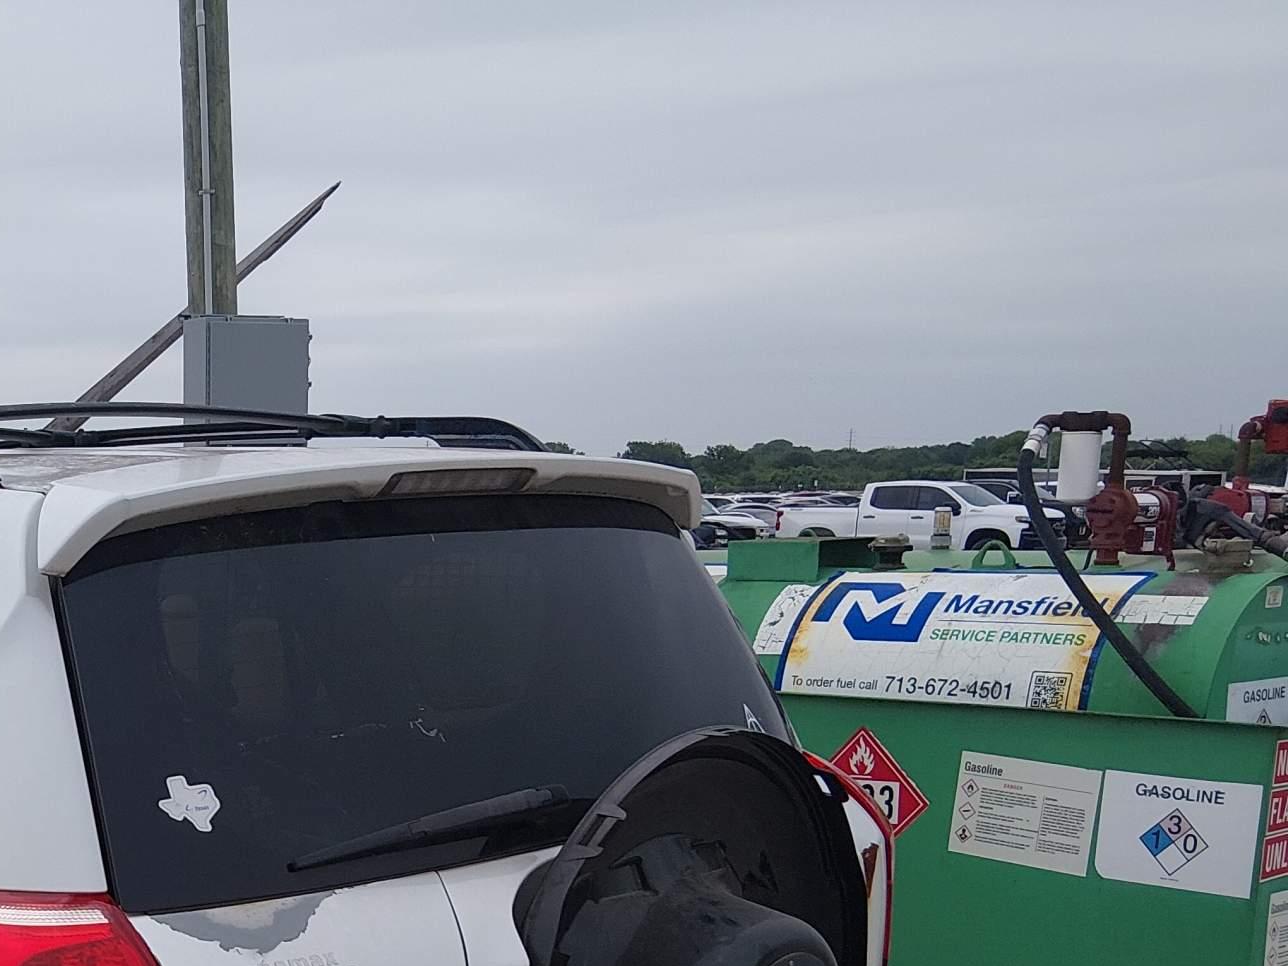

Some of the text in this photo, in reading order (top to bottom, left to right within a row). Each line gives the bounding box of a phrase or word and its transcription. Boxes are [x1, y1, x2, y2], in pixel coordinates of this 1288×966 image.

[929, 628, 1087, 646] SERVICE PARTNERS
[791, 675, 1013, 700] To order fuel call 713-672-4501
[1243, 686, 1286, 704] GASOLINE
[964, 761, 1003, 776] Gasoline
[1135, 783, 1226, 805] GASOLINE
[1167, 814, 1182, 835] 3
[1151, 829, 1161, 849] 1
[1183, 833, 1198, 854] 0
